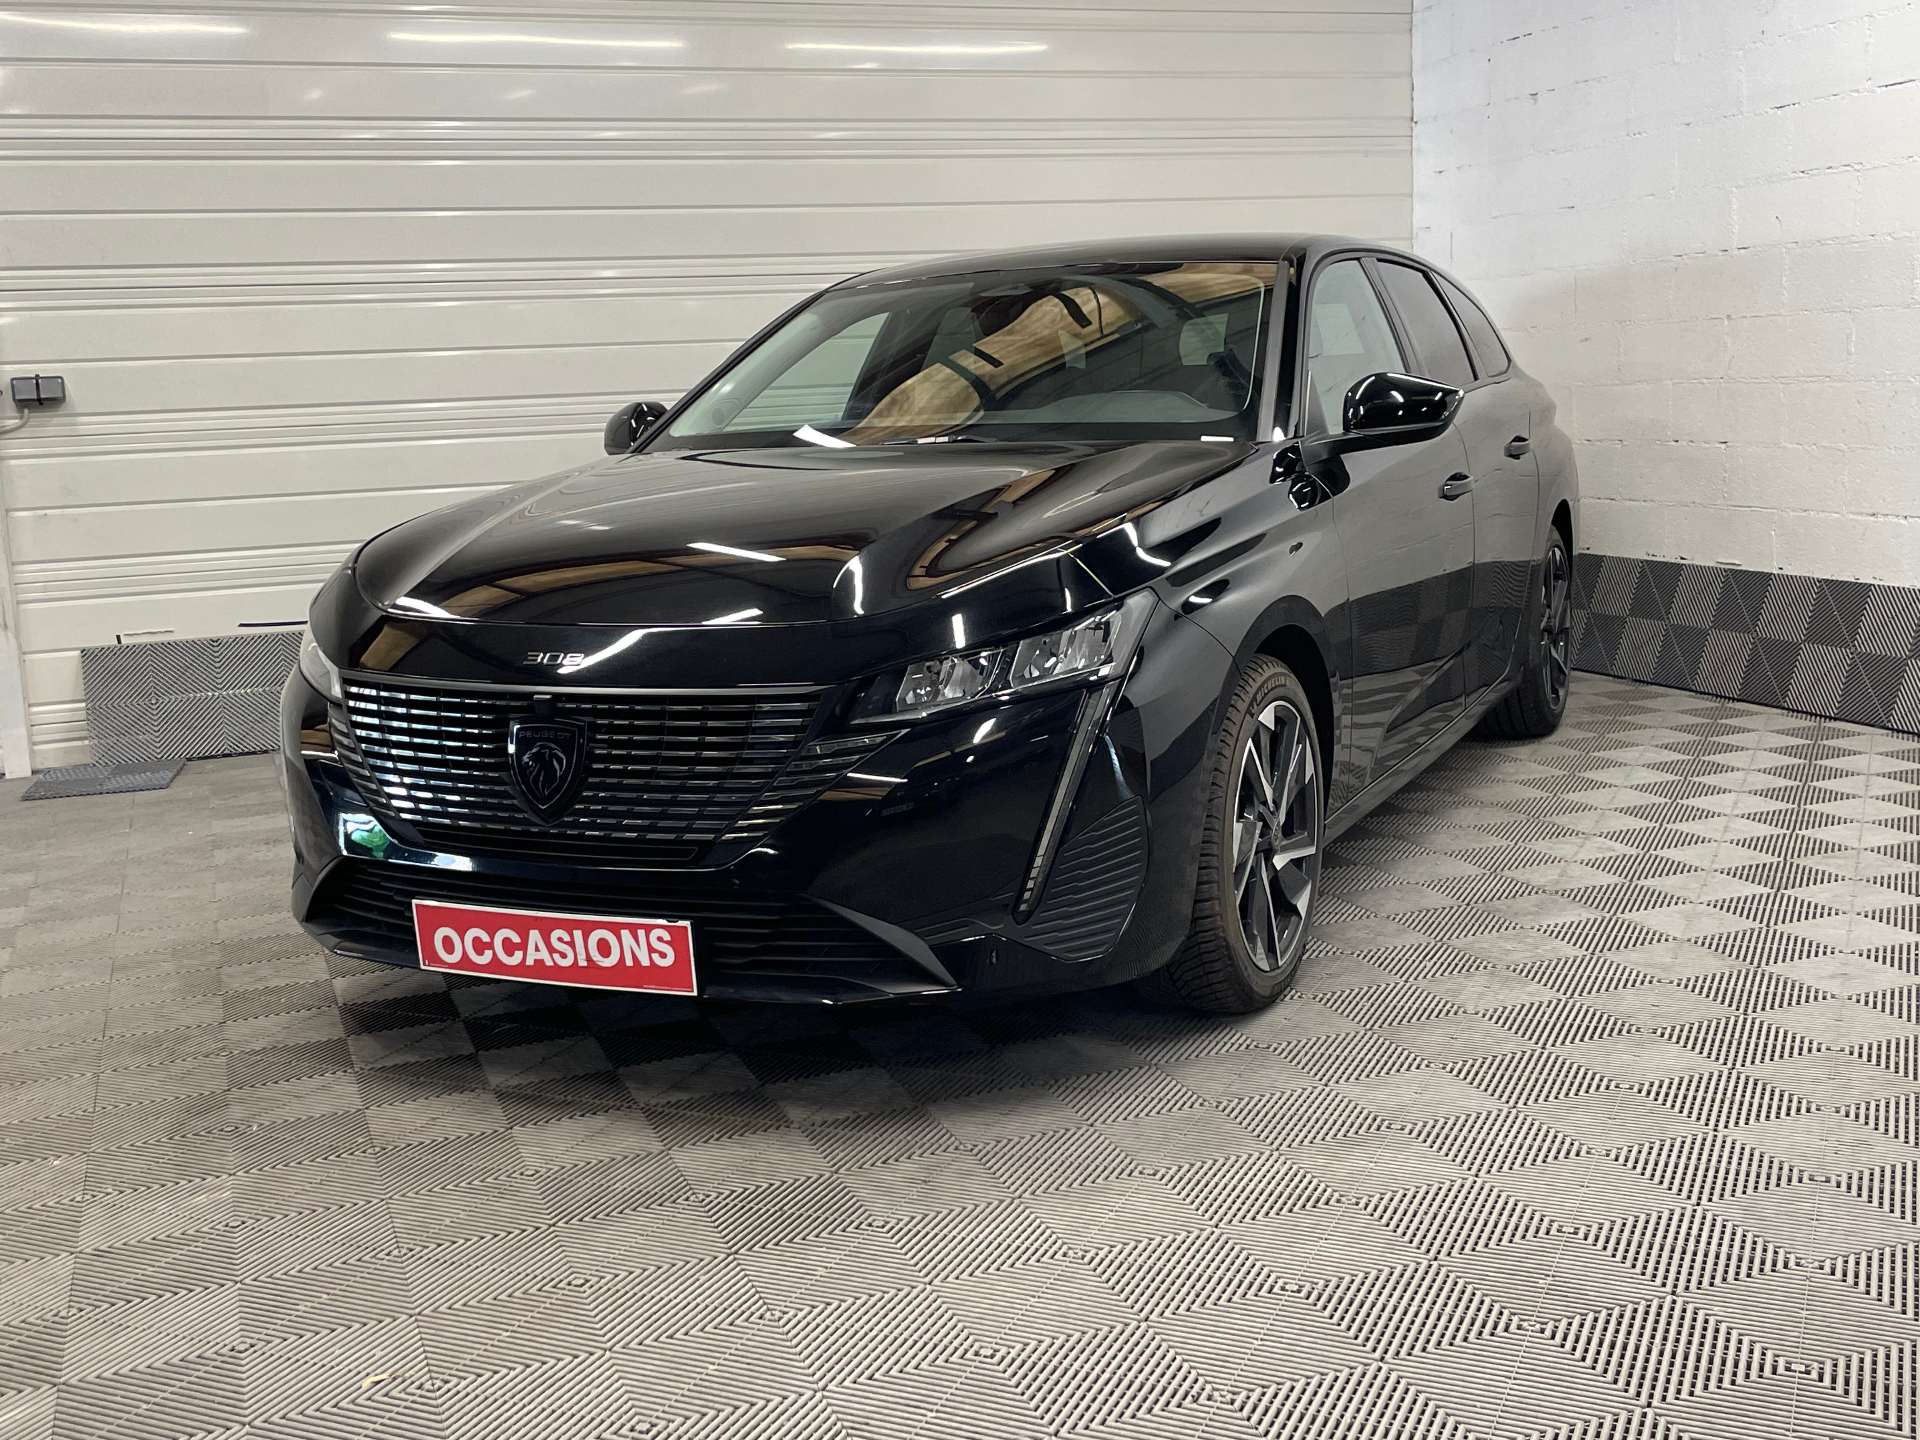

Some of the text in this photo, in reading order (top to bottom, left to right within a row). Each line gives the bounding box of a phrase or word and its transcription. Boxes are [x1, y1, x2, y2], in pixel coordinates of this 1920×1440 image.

[523, 651, 585, 666] 308
[1256, 675, 1287, 706] MICHELIN
[518, 730, 572, 740] PEUGEOT
[433, 926, 676, 968] OCCASIONS
